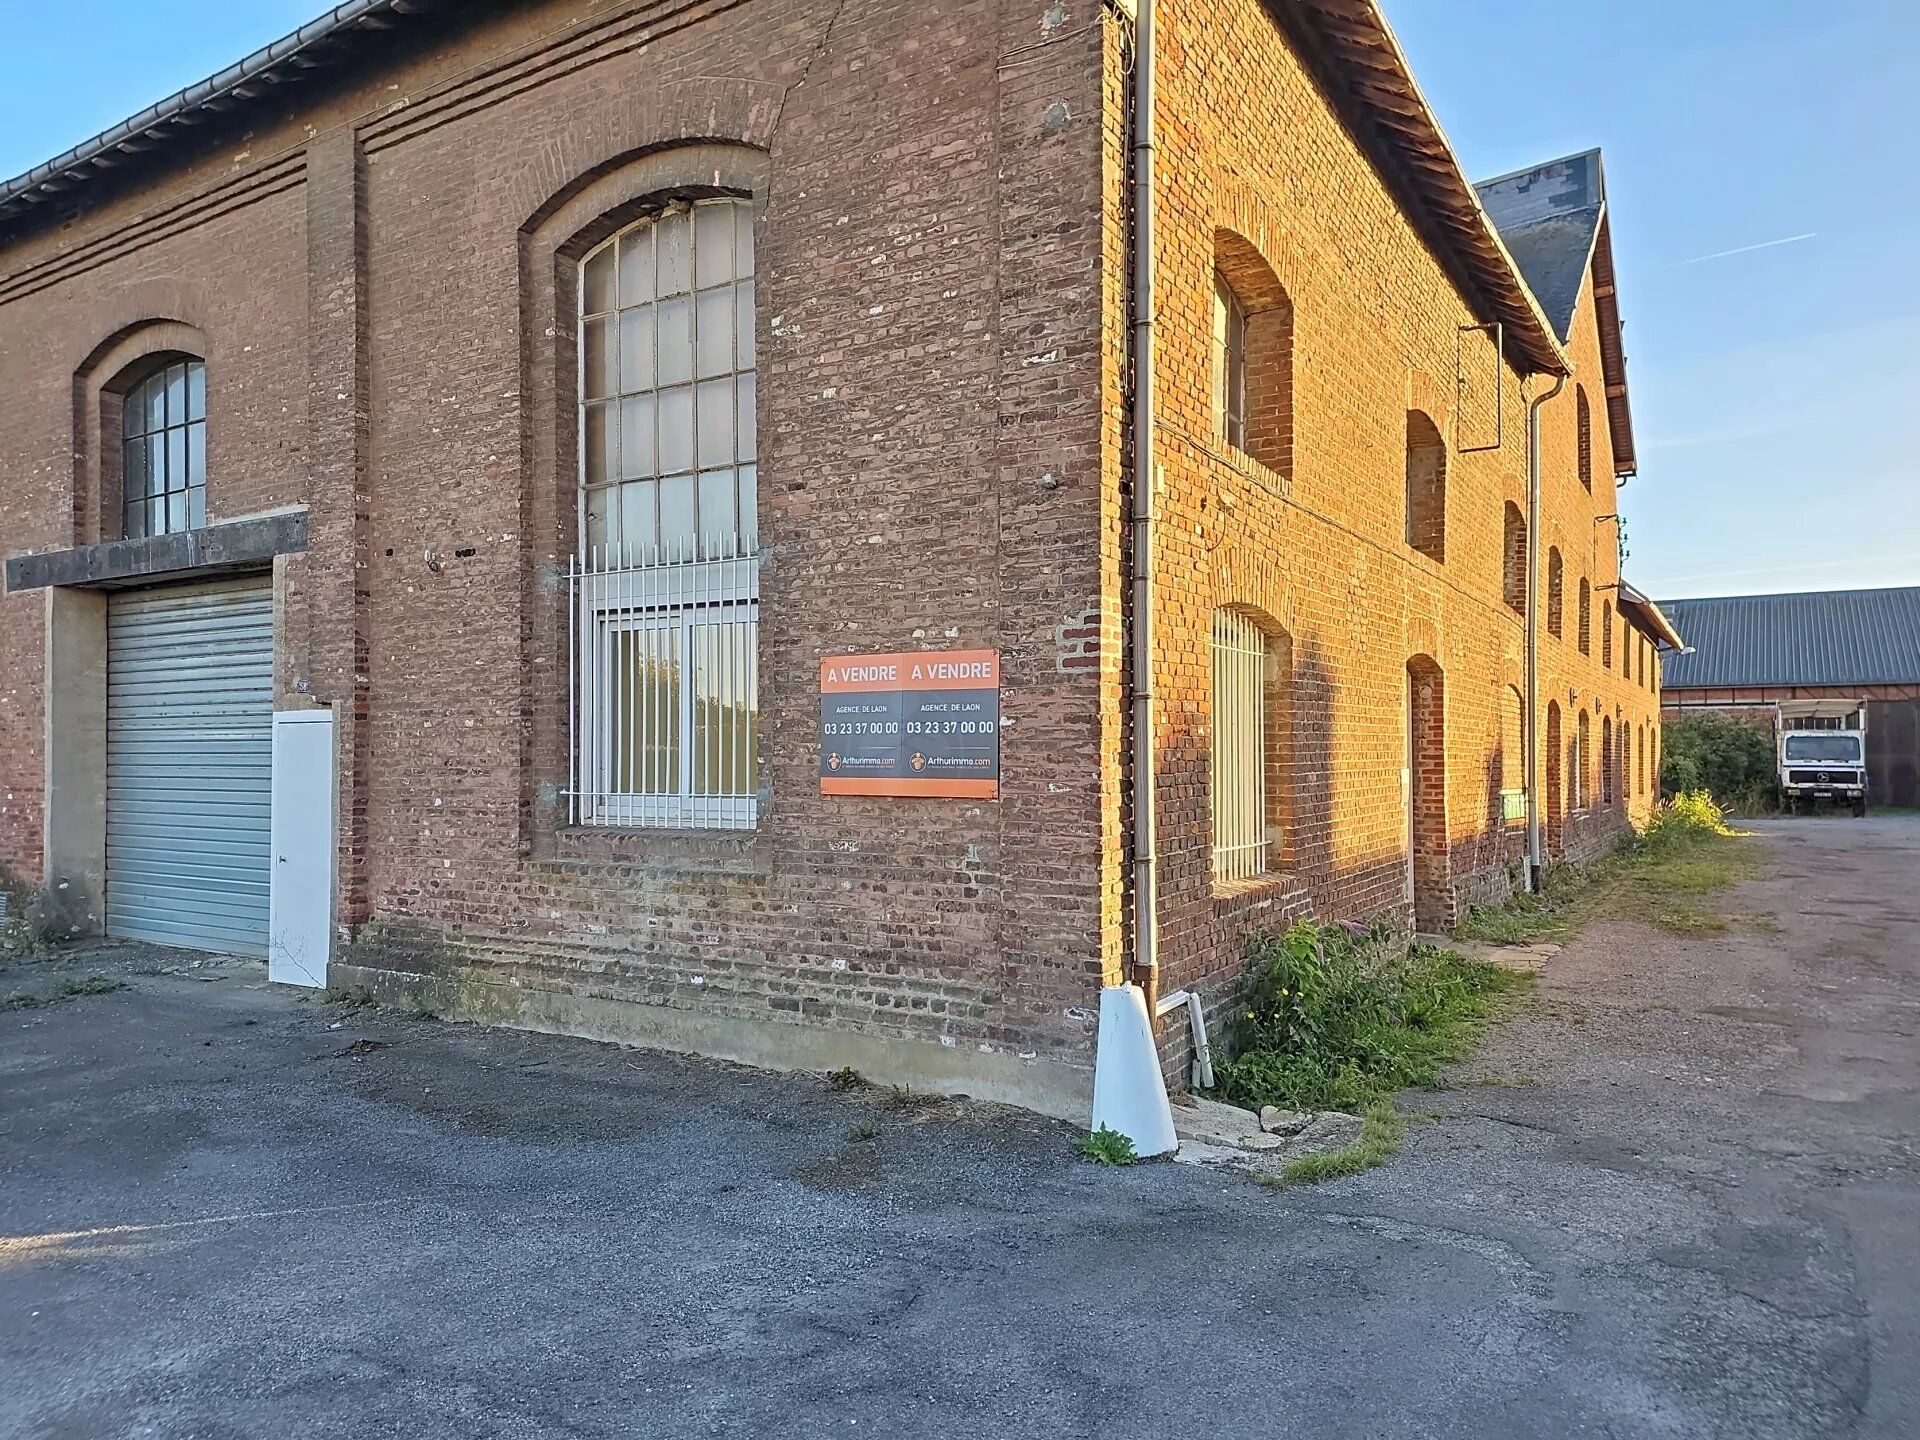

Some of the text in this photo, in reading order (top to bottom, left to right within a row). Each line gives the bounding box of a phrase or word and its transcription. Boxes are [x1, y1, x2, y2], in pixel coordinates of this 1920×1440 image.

[827, 665, 897, 683] A VENDRE
[911, 662, 992, 680] A VENDRE
[836, 705, 888, 714] AGENCE DE LAON
[920, 704, 948, 712] AGENCE
[961, 703, 981, 711] LAON
[824, 722, 898, 735] 03 23 37 00 00
[906, 721, 994, 734] 03 23 37 00 00
[842, 756, 896, 765] Arthurimmo.com
[927, 756, 991, 766] Arthurimmo.com
